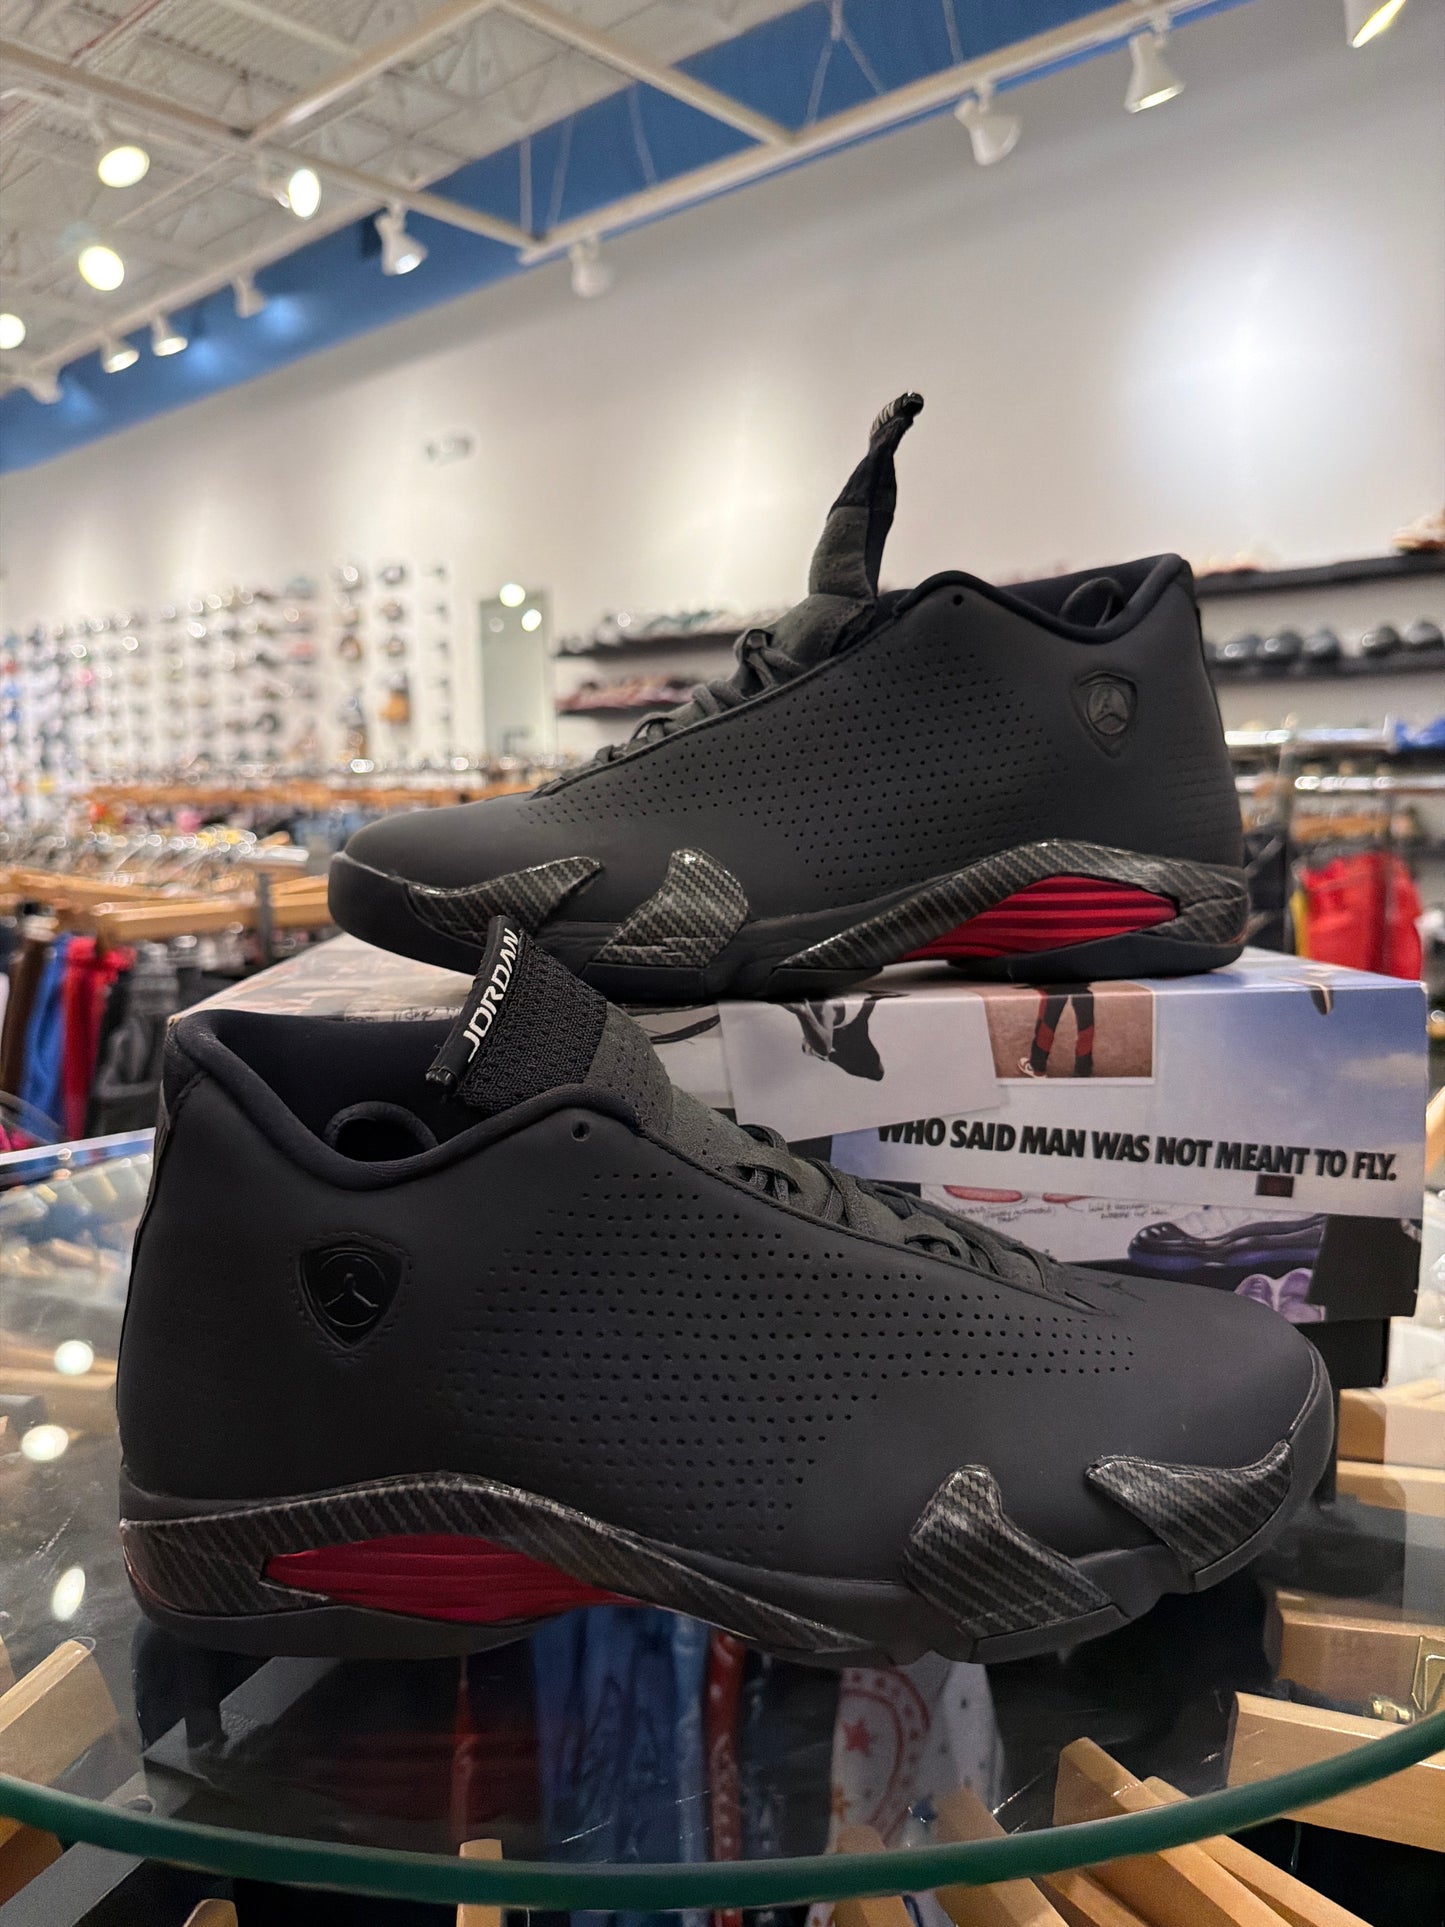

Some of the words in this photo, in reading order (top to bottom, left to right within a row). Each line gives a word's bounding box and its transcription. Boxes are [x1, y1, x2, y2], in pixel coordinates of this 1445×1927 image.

[463, 928, 519, 1063] JORDAN
[878, 1118, 946, 1147] WHO
[949, 1120, 1016, 1152] SAID
[1019, 1126, 1086, 1158] MAN
[1091, 1131, 1150, 1163] WAS
[1155, 1136, 1212, 1167] NOT
[1214, 1141, 1310, 1174] MEANT
[1314, 1148, 1347, 1178] TO
[1352, 1151, 1397, 1181] FLY.
